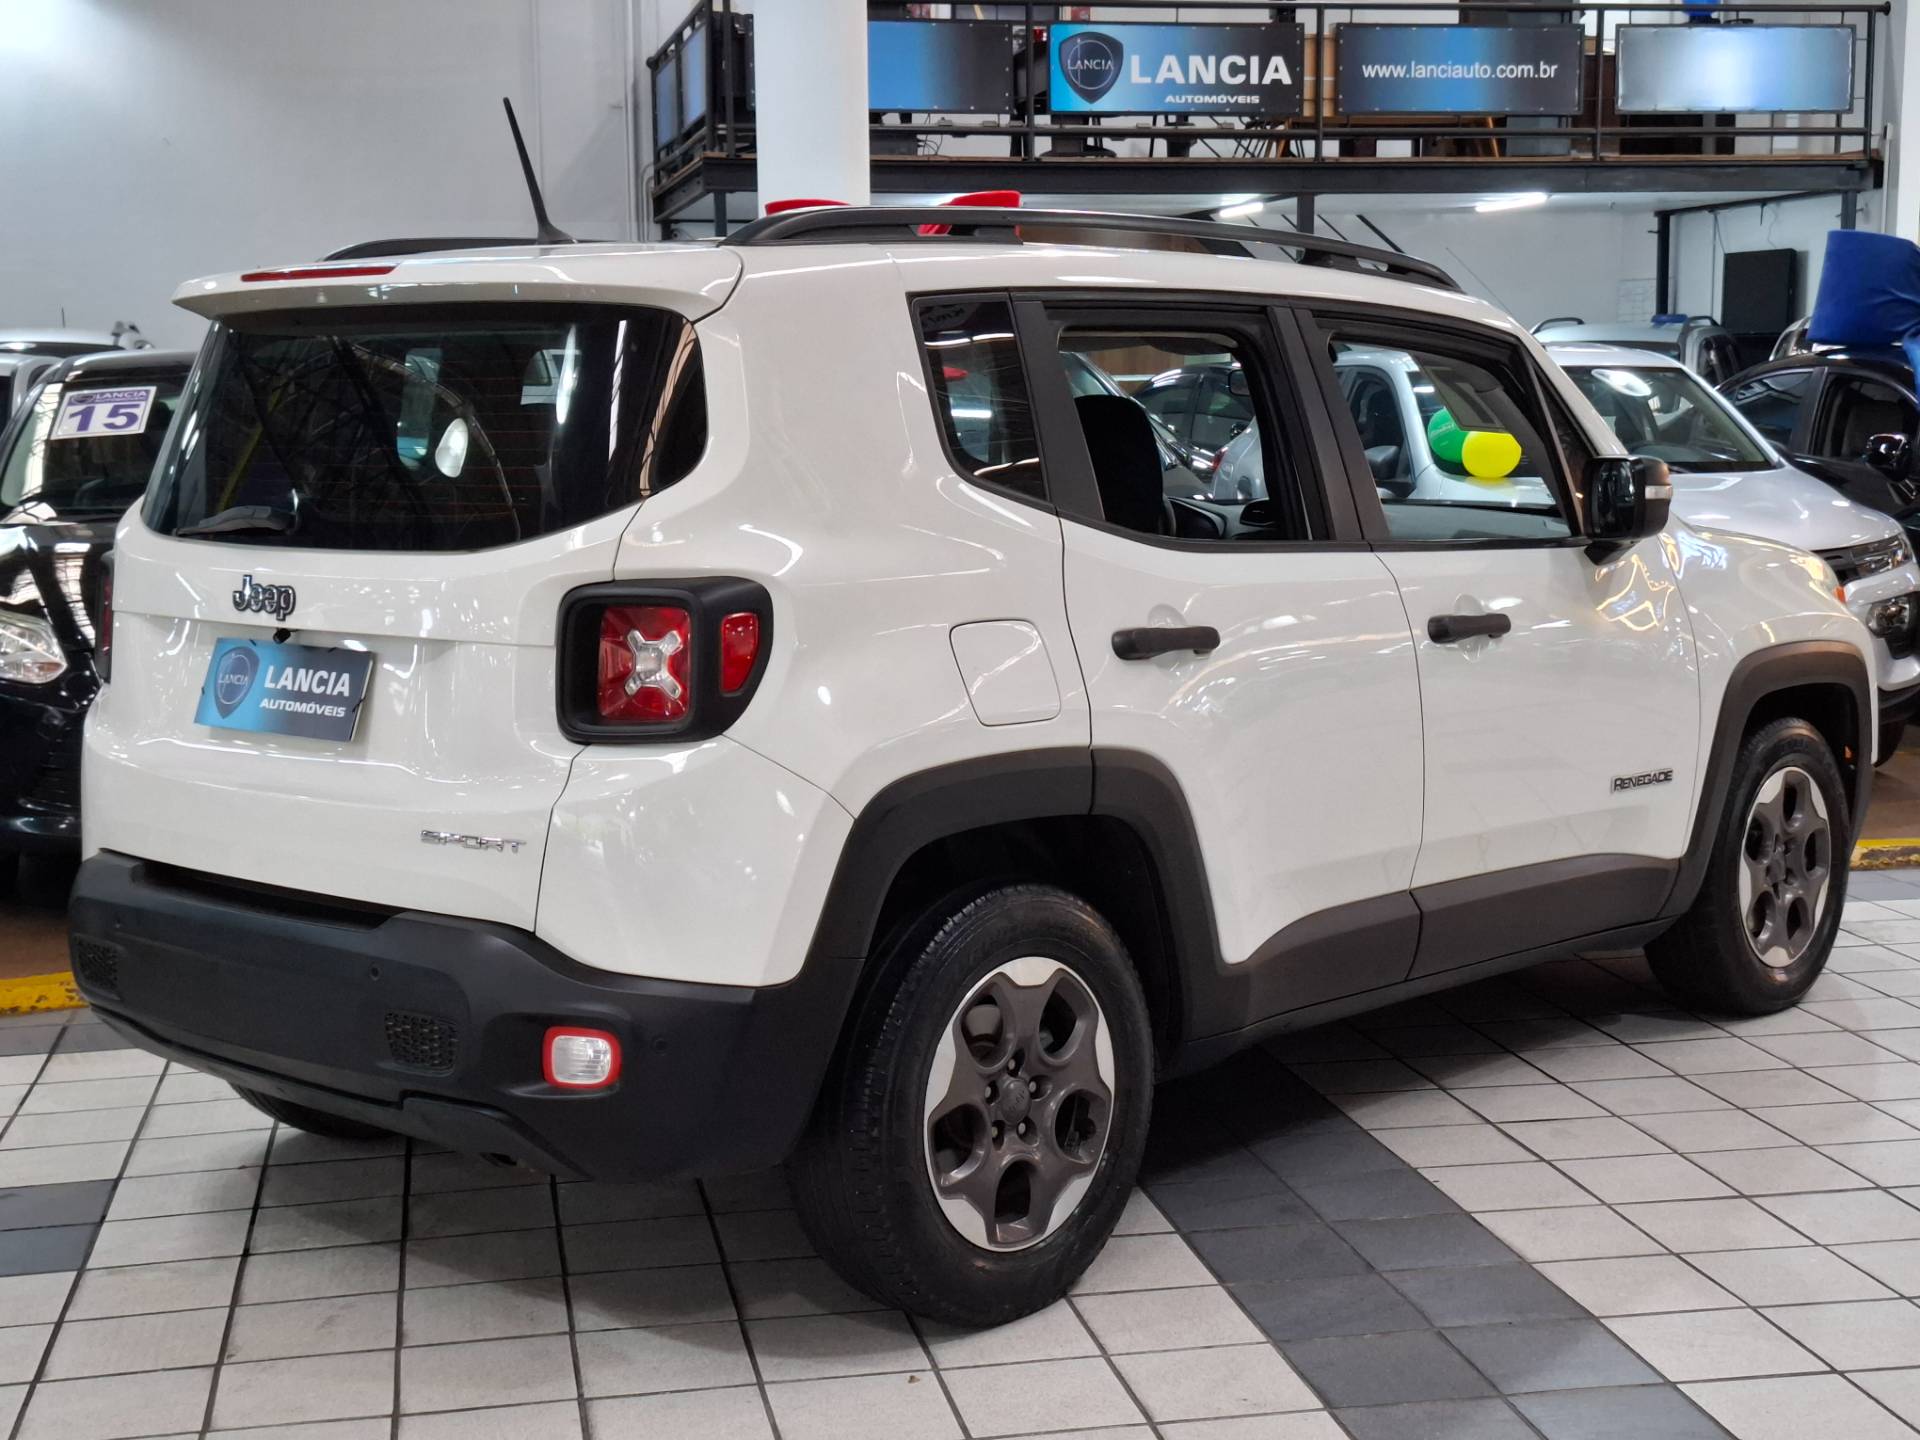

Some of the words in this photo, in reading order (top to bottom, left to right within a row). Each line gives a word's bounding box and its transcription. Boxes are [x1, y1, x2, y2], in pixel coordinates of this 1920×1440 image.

[1067, 59, 1114, 70] LANCIA
[1130, 54, 1293, 85] LANCIA
[1362, 60, 1558, 79] www.lanciauto.com.br
[1164, 93, 1260, 104] AUTOMÓVEIS
[95, 390, 147, 400] LANCIA
[68, 403, 140, 432] 15
[232, 574, 296, 621] Jeep
[217, 671, 249, 686] LANCIA
[264, 664, 351, 697] LANCIA
[258, 697, 347, 718] AUTOMÓVEIS
[1612, 769, 1674, 793] RENEGADE
[420, 829, 527, 854] SPORT
